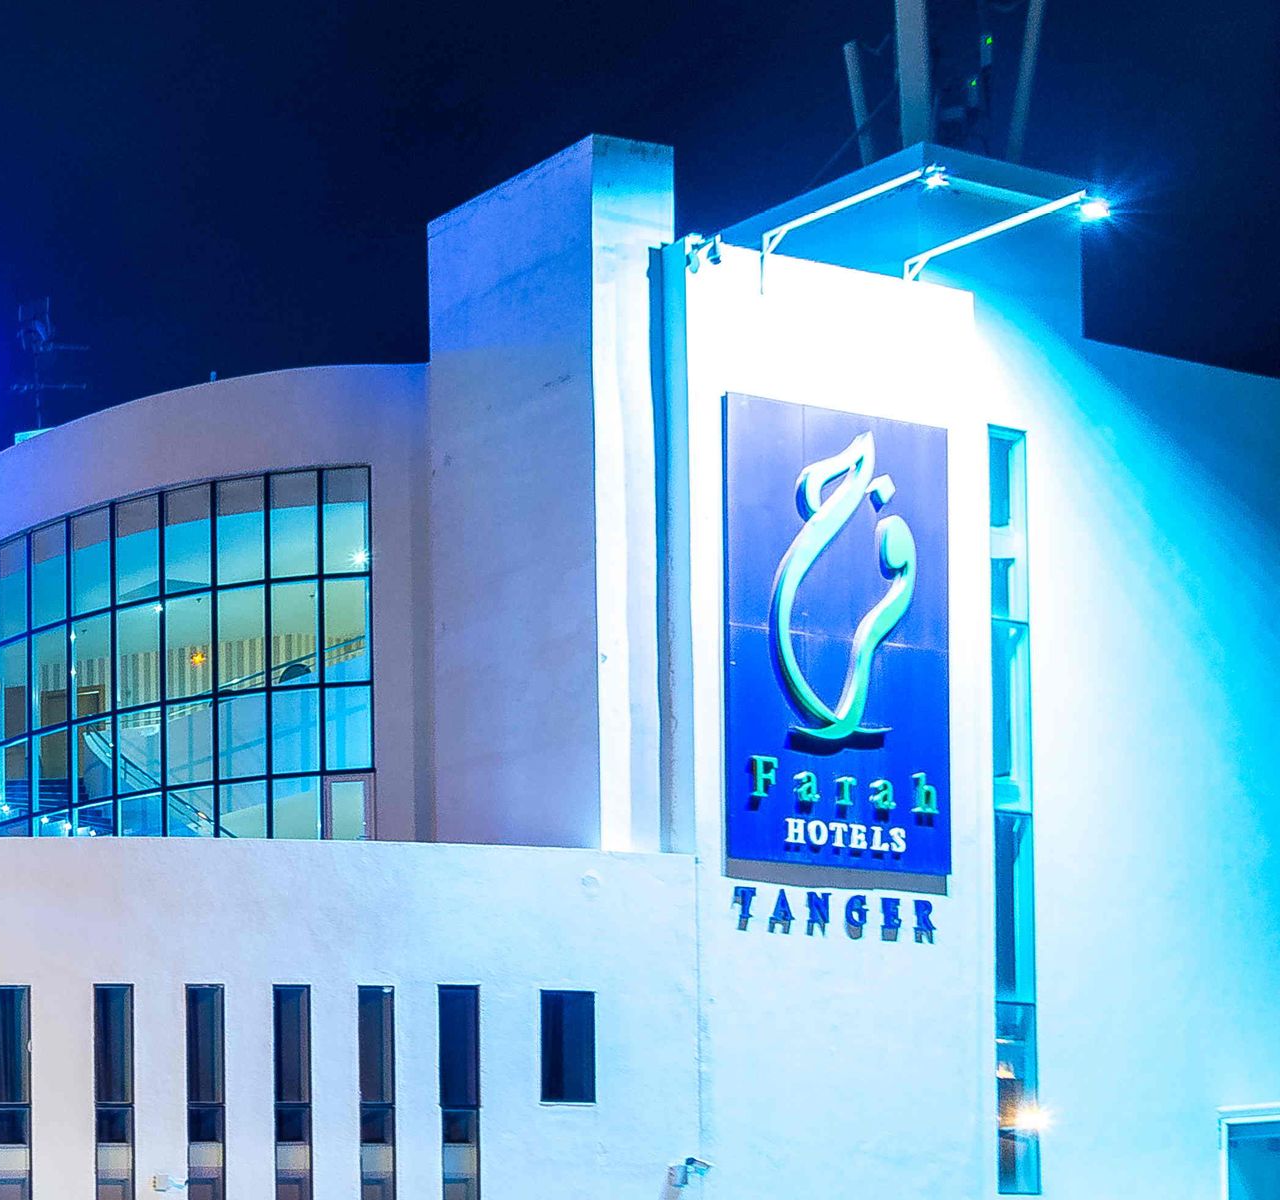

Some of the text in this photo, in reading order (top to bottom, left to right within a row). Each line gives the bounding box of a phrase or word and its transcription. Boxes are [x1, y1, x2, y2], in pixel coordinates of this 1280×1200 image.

[750, 755, 939, 814] Farah
[784, 817, 906, 853] HOTELS
[733, 886, 936, 931] TANGER
